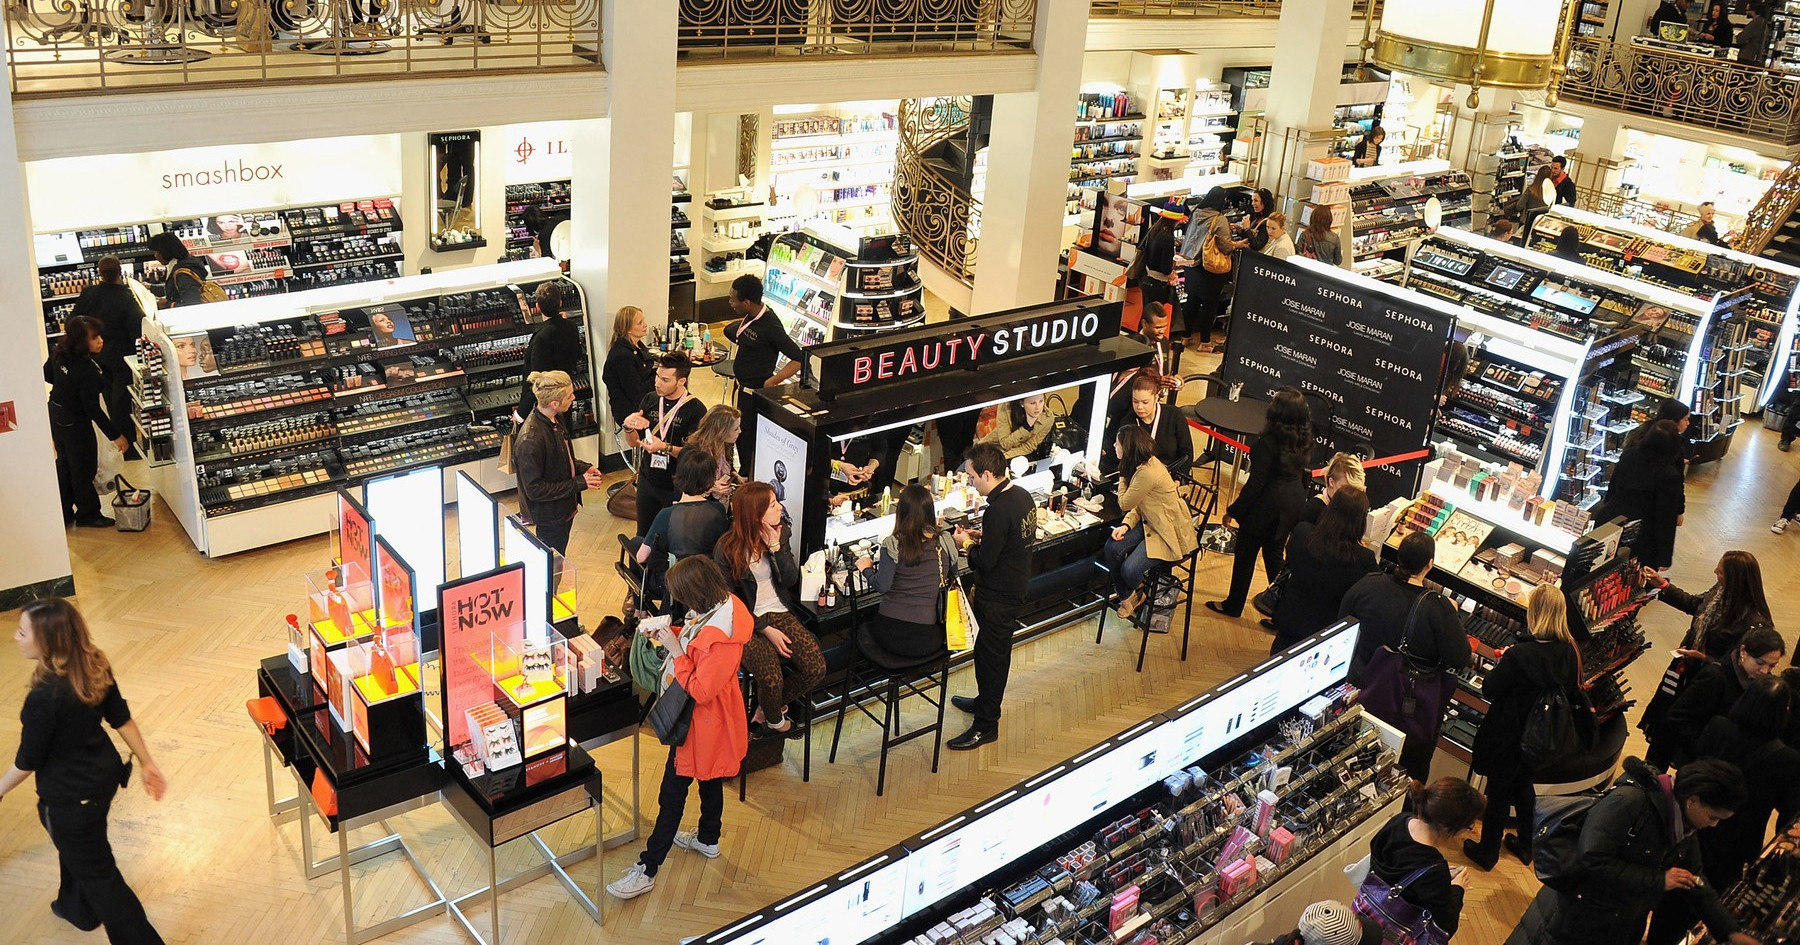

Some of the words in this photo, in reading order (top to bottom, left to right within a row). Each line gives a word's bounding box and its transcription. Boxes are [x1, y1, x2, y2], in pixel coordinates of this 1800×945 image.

[440, 134, 471, 143] SEPHORA
[547, 141, 570, 154] IL
[162, 159, 283, 189] smashbox
[1254, 266, 1296, 287] SEPHORA
[1281, 298, 1300, 310] JOSIE
[1300, 304, 1326, 318] MARAN
[1317, 287, 1363, 309] SEPHORA
[1246, 312, 1289, 333] SEPHORA
[1346, 320, 1366, 333] JOSIE
[1366, 327, 1393, 342] MARAN
[1385, 309, 1433, 332] SEPHORA
[357, 352, 374, 362] NARS
[399, 342, 440, 356] COLLECTION
[853, 333, 986, 384] BEAUTY
[992, 313, 1099, 355] STUDIO
[1274, 344, 1292, 356] JOSIE
[1292, 350, 1317, 365] MARAN
[1309, 334, 1353, 357] SEPHORA
[1240, 356, 1281, 378] SEPHORA
[1375, 358, 1422, 381] SEPHORA
[1337, 368, 1357, 380] JOSIE
[1357, 374, 1382, 390] MARAN
[359, 393, 375, 403] NARS
[375, 386, 407, 401] ORGASM
[407, 381, 446, 395] COLLECTION
[1329, 415, 1348, 427] OSIE
[1348, 421, 1374, 437] MARAN
[1365, 405, 1412, 430] SEPHORA
[1356, 452, 1402, 478] SEORA
[345, 512, 363, 541] HOT
[347, 528, 368, 560] NOW
[457, 587, 504, 615] HOT
[458, 600, 514, 632] NOW
